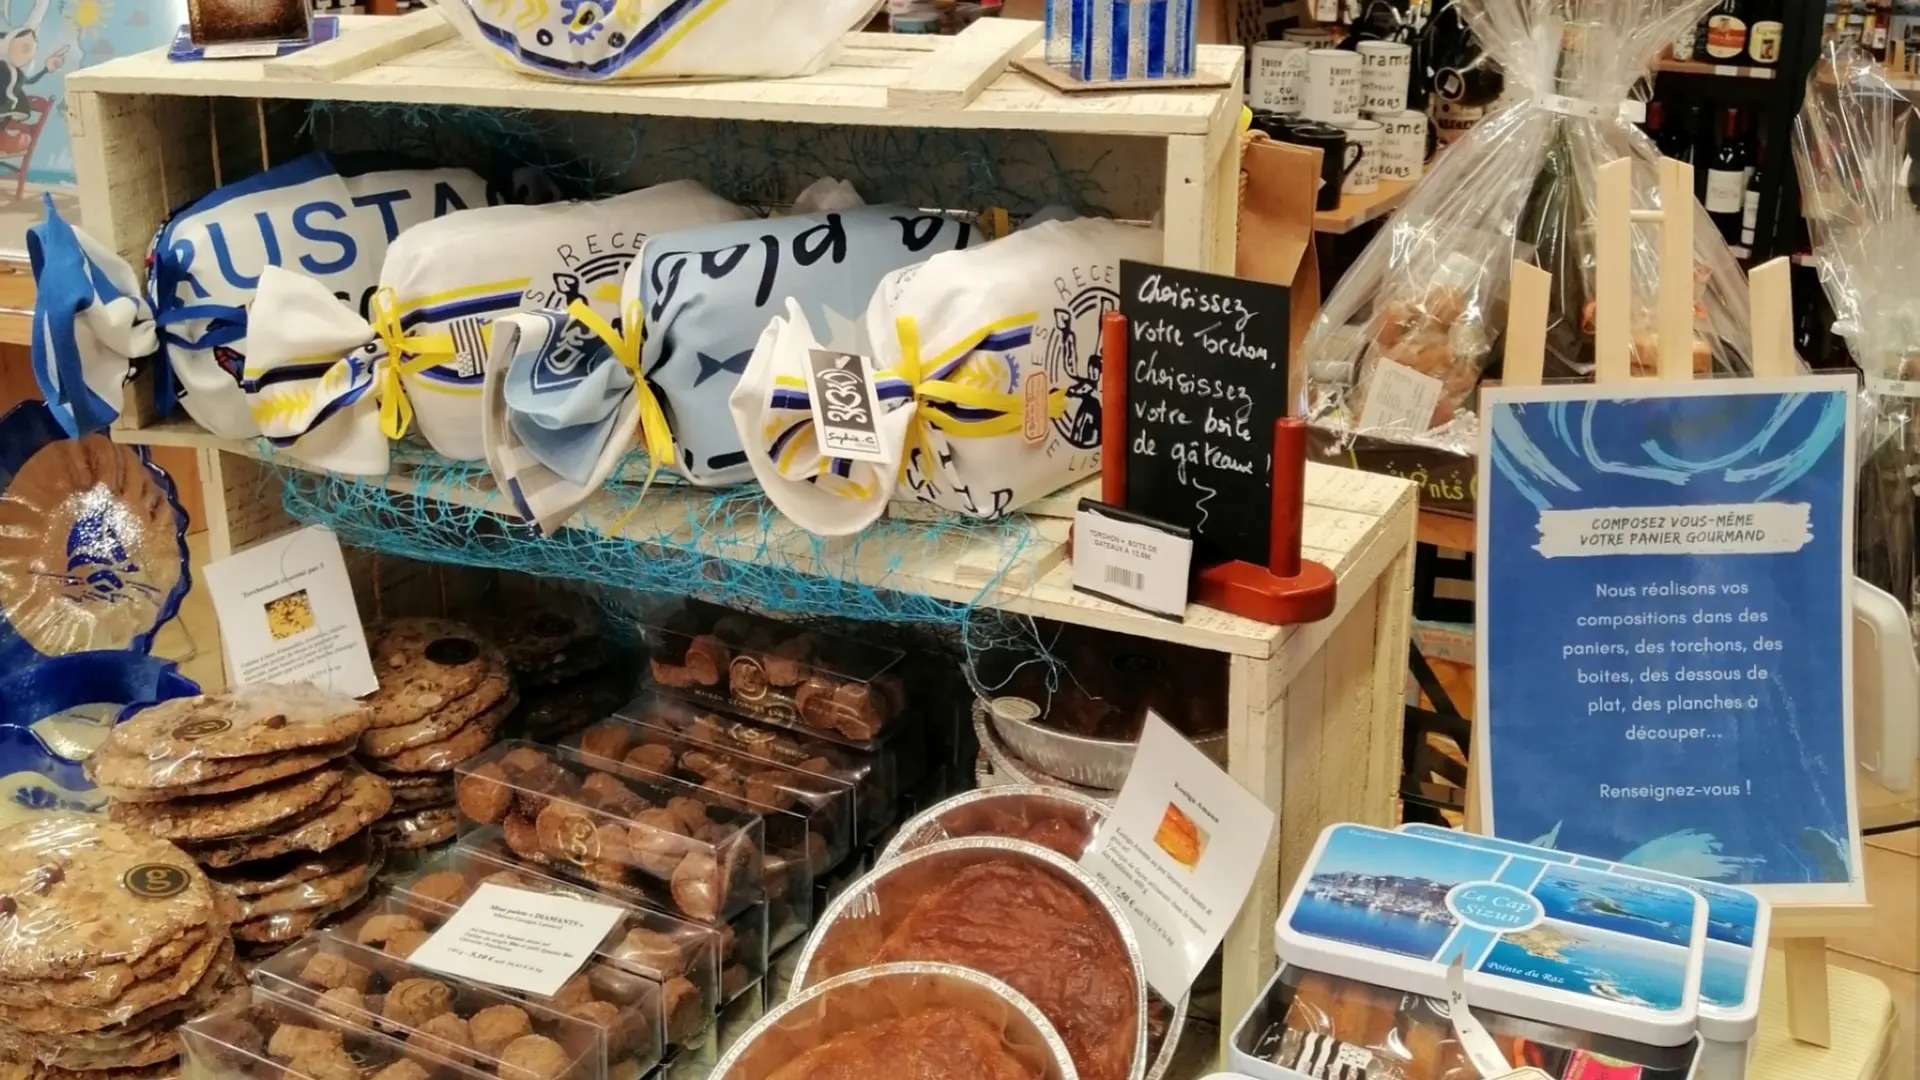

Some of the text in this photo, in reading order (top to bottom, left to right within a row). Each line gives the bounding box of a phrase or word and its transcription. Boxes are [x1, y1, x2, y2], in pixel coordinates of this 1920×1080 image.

[1138, 274, 1259, 332] Choisissez
[1135, 350, 1254, 421] Choisissez
[1133, 429, 1158, 456] de
[1591, 512, 1754, 530] COMPOSEZ VOUS-MÊME
[1580, 528, 1766, 546] VOTRE PANIER GOURMAND
[1596, 579, 1749, 599] Nous réalisons vos
[1576, 607, 1768, 630] compositions dans des
[1562, 635, 1783, 659] paniers, des torchons, des
[1577, 665, 1768, 685] boites, des dessous de
[1588, 694, 1758, 716] plat, des planches à
[1625, 723, 1722, 742] découper...
[1600, 779, 1751, 802] Renseignez-vous !
[1460, 889, 1532, 913] Le Cap
[1460, 904, 1521, 924] Sizun
[1487, 960, 1565, 984] Pointe du Raz
